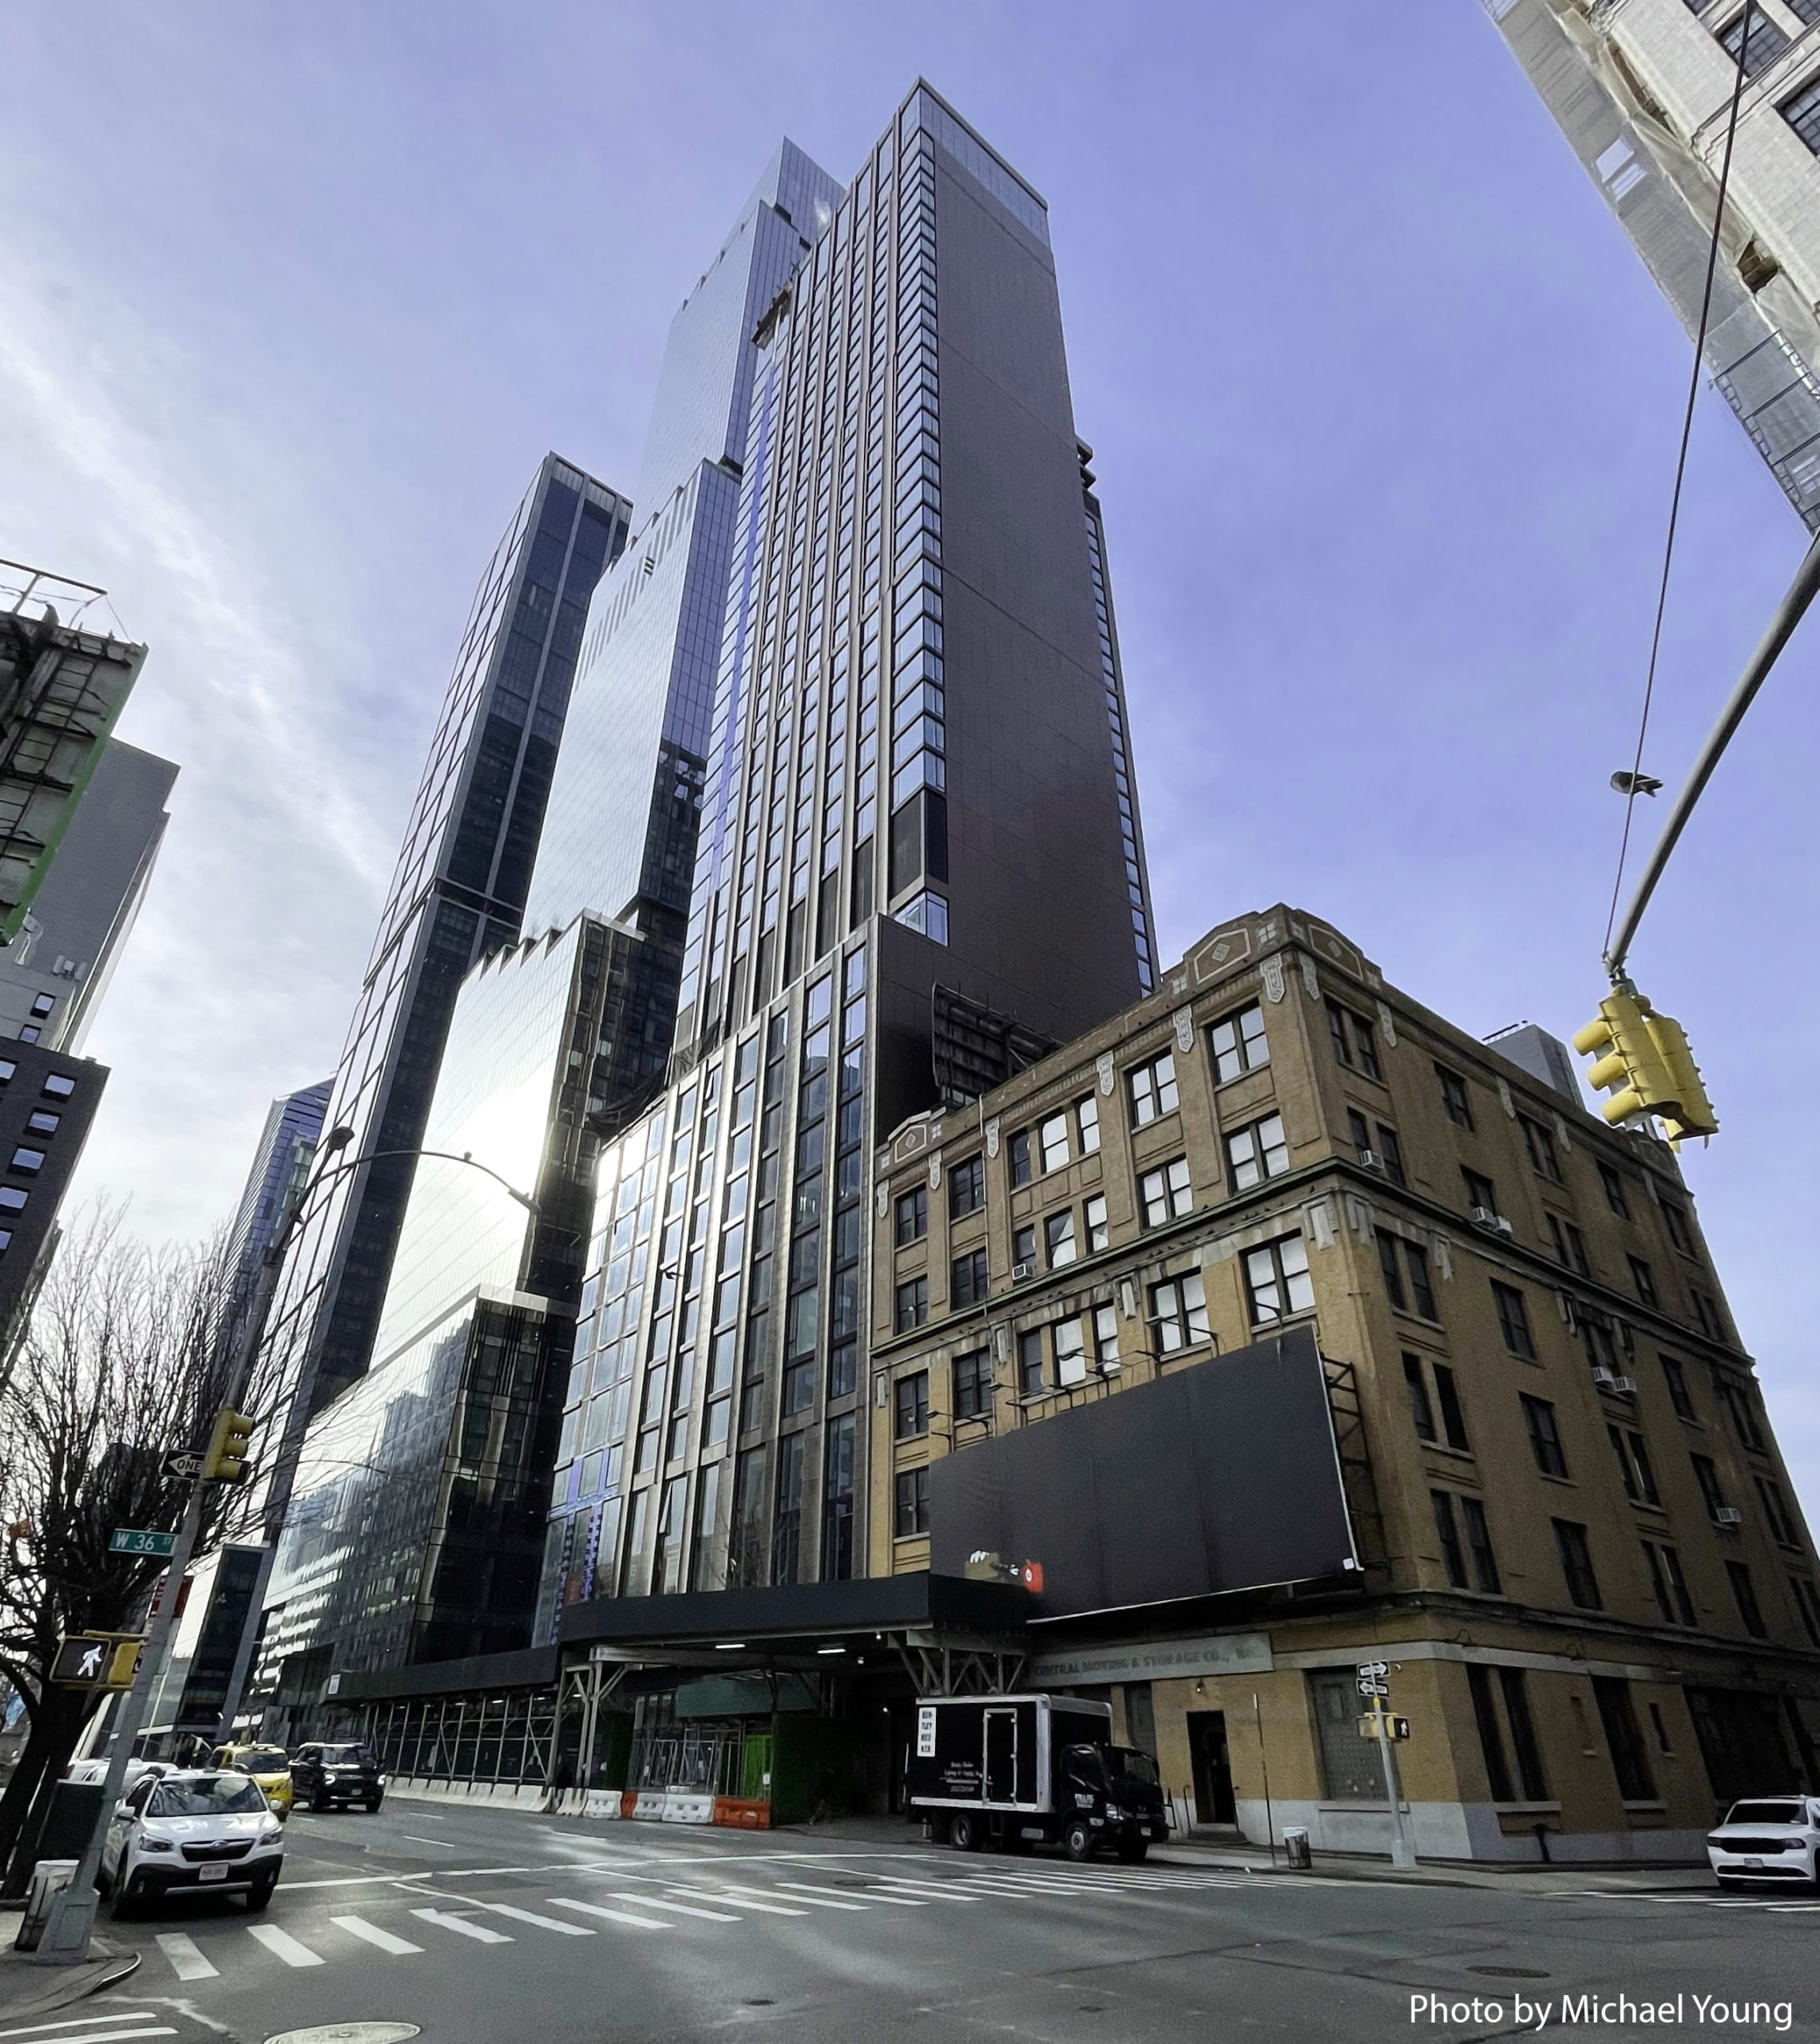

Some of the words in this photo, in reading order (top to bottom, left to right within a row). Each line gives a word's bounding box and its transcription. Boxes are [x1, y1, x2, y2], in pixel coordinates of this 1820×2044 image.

[176, 1459, 200, 1472] ONE
[116, 1532, 129, 1548] W
[134, 1534, 155, 1551] 36
[162, 1536, 172, 1546] ST
